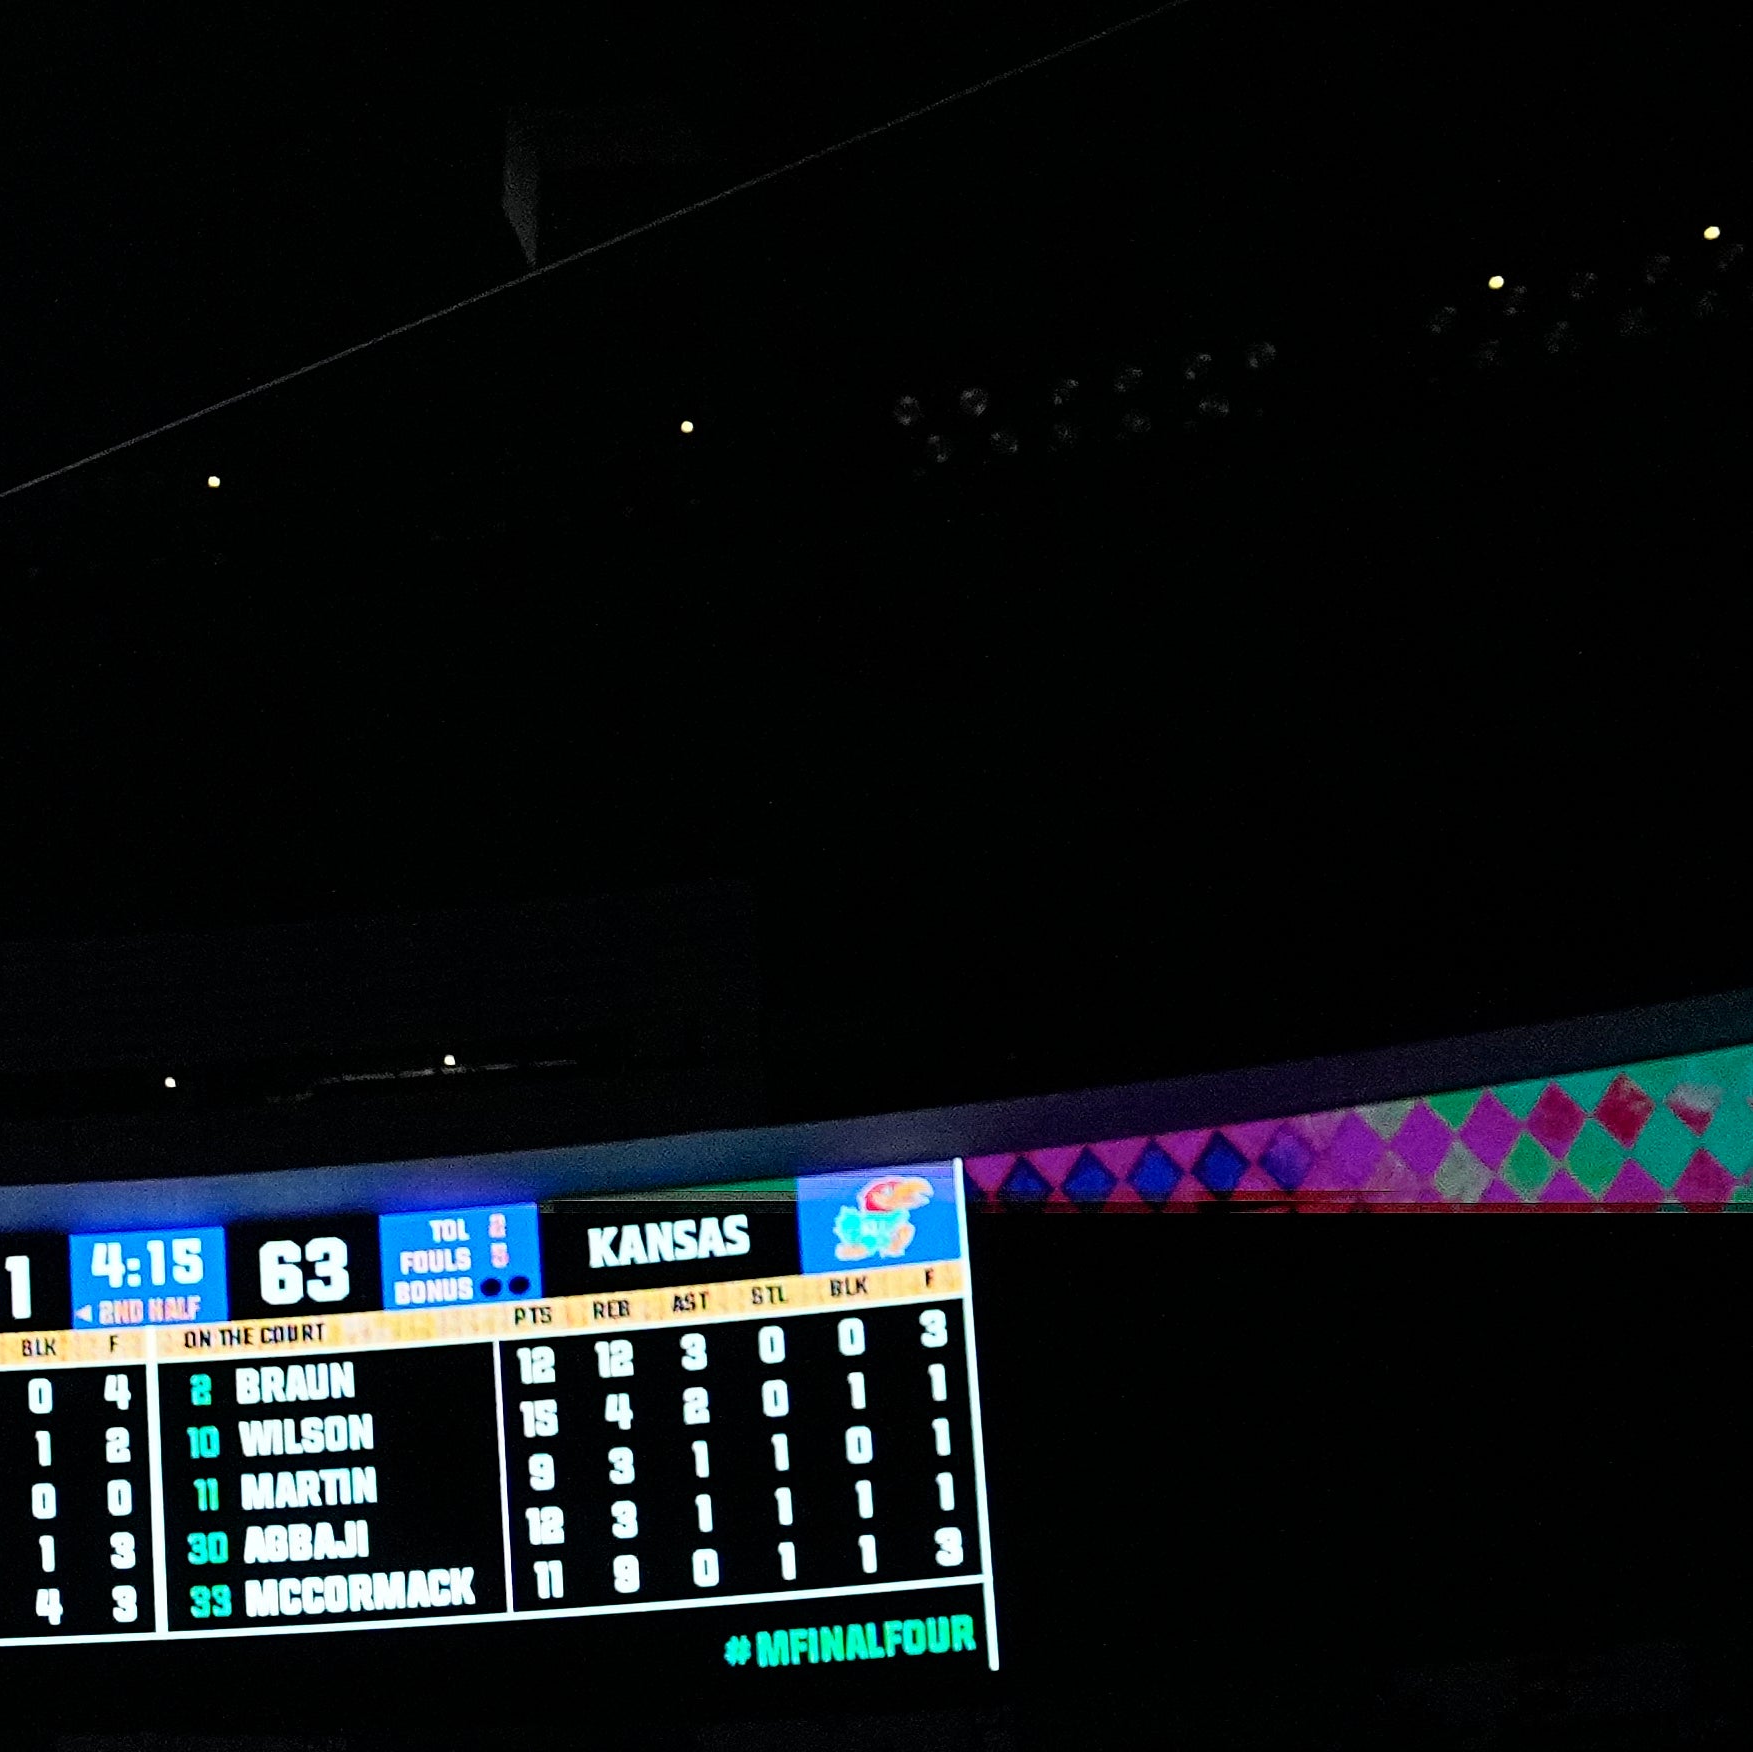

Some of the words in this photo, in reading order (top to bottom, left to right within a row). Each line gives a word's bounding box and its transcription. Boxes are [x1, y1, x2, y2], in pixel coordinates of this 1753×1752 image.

[430, 1218, 470, 1242] TOL
[588, 1214, 750, 1268] KANSAS
[91, 1238, 203, 1288] 4:15
[260, 1237, 349, 1305] 63
[400, 1247, 471, 1275] FOULS
[98, 1299, 143, 1324] 2ND
[148, 1295, 201, 1321] HALF
[394, 1277, 473, 1304] BONUS
[514, 1306, 553, 1327] PTS
[593, 1300, 631, 1321] REB
[673, 1293, 710, 1314] AST
[751, 1286, 787, 1306] STL
[830, 1276, 869, 1298] BLK
[925, 1270, 935, 1288] F
[22, 1337, 56, 1358] BLK
[110, 1334, 119, 1353] F
[184, 1330, 213, 1349] ON
[219, 1326, 254, 1346] THE
[260, 1323, 326, 1345] COURT
[236, 1362, 355, 1404] BRAUN
[517, 1346, 555, 1384] 12
[595, 1340, 634, 1378] 12
[680, 1333, 707, 1371] 3
[759, 1326, 785, 1364] 0
[838, 1318, 865, 1356] 0
[919, 1309, 947, 1347] 3
[28, 1378, 53, 1414] 0
[104, 1374, 131, 1410] 4
[187, 1426, 220, 1458] 10
[238, 1414, 373, 1457] WILSON
[520, 1399, 558, 1437] 15
[605, 1393, 633, 1430] 4
[683, 1387, 710, 1424] 2
[762, 1380, 789, 1417] 0
[848, 1372, 866, 1409] 1
[928, 1364, 947, 1401] 1
[35, 1431, 51, 1466] 1
[106, 1427, 131, 1463] 2
[194, 1478, 219, 1511] 11
[241, 1466, 377, 1510] MARTIN
[529, 1453, 555, 1491] 9
[608, 1447, 635, 1484] 3
[692, 1441, 709, 1477] 1
[771, 1433, 789, 1471] 1
[846, 1426, 873, 1464] 0
[932, 1418, 951, 1456] 1
[32, 1483, 56, 1519] 0
[107, 1479, 132, 1516] 0
[187, 1532, 228, 1565] 30
[244, 1520, 369, 1564] AGBAJI
[525, 1506, 564, 1545] 12
[611, 1500, 638, 1538] 3
[695, 1494, 713, 1532] 1
[775, 1487, 793, 1525] 1
[855, 1480, 873, 1518] 1
[936, 1472, 954, 1511] 1
[39, 1535, 55, 1572] 1
[110, 1532, 135, 1569] 3
[245, 1567, 475, 1617] MCCORMACK
[534, 1560, 563, 1599] 11
[692, 1549, 719, 1587] 0
[778, 1542, 796, 1580] 1
[859, 1535, 877, 1573] 1
[935, 1527, 963, 1566] 3
[36, 1588, 63, 1625] 4
[112, 1585, 137, 1622] 3
